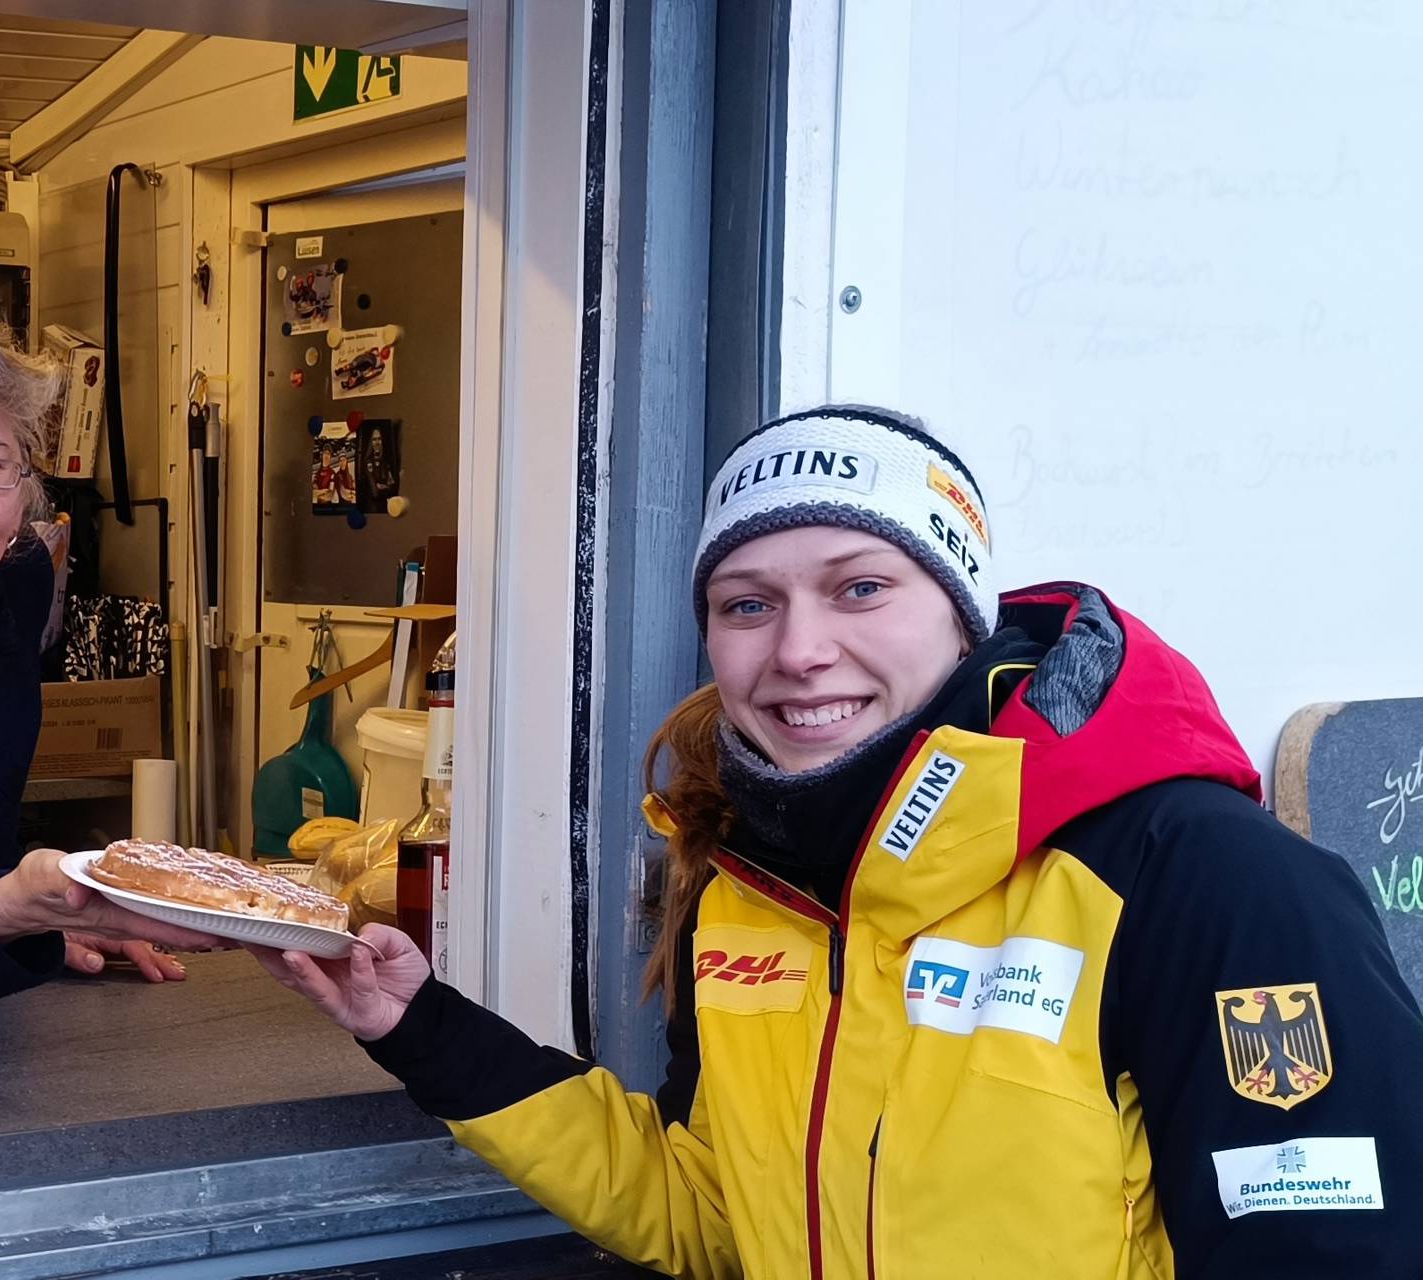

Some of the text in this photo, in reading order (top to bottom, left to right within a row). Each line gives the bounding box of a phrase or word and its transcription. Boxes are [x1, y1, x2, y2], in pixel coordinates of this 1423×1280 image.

[720, 449, 859, 507] VELTINS
[945, 481, 986, 539] DHL
[884, 757, 957, 852] VELTINS
[695, 949, 790, 986] DHL
[1041, 997, 1065, 1017] eG
[1239, 1176, 1352, 1196] Bundeswehr
[1244, 1195, 1291, 1209] Dienen.
[1292, 1193, 1377, 1206] Deutschland.
